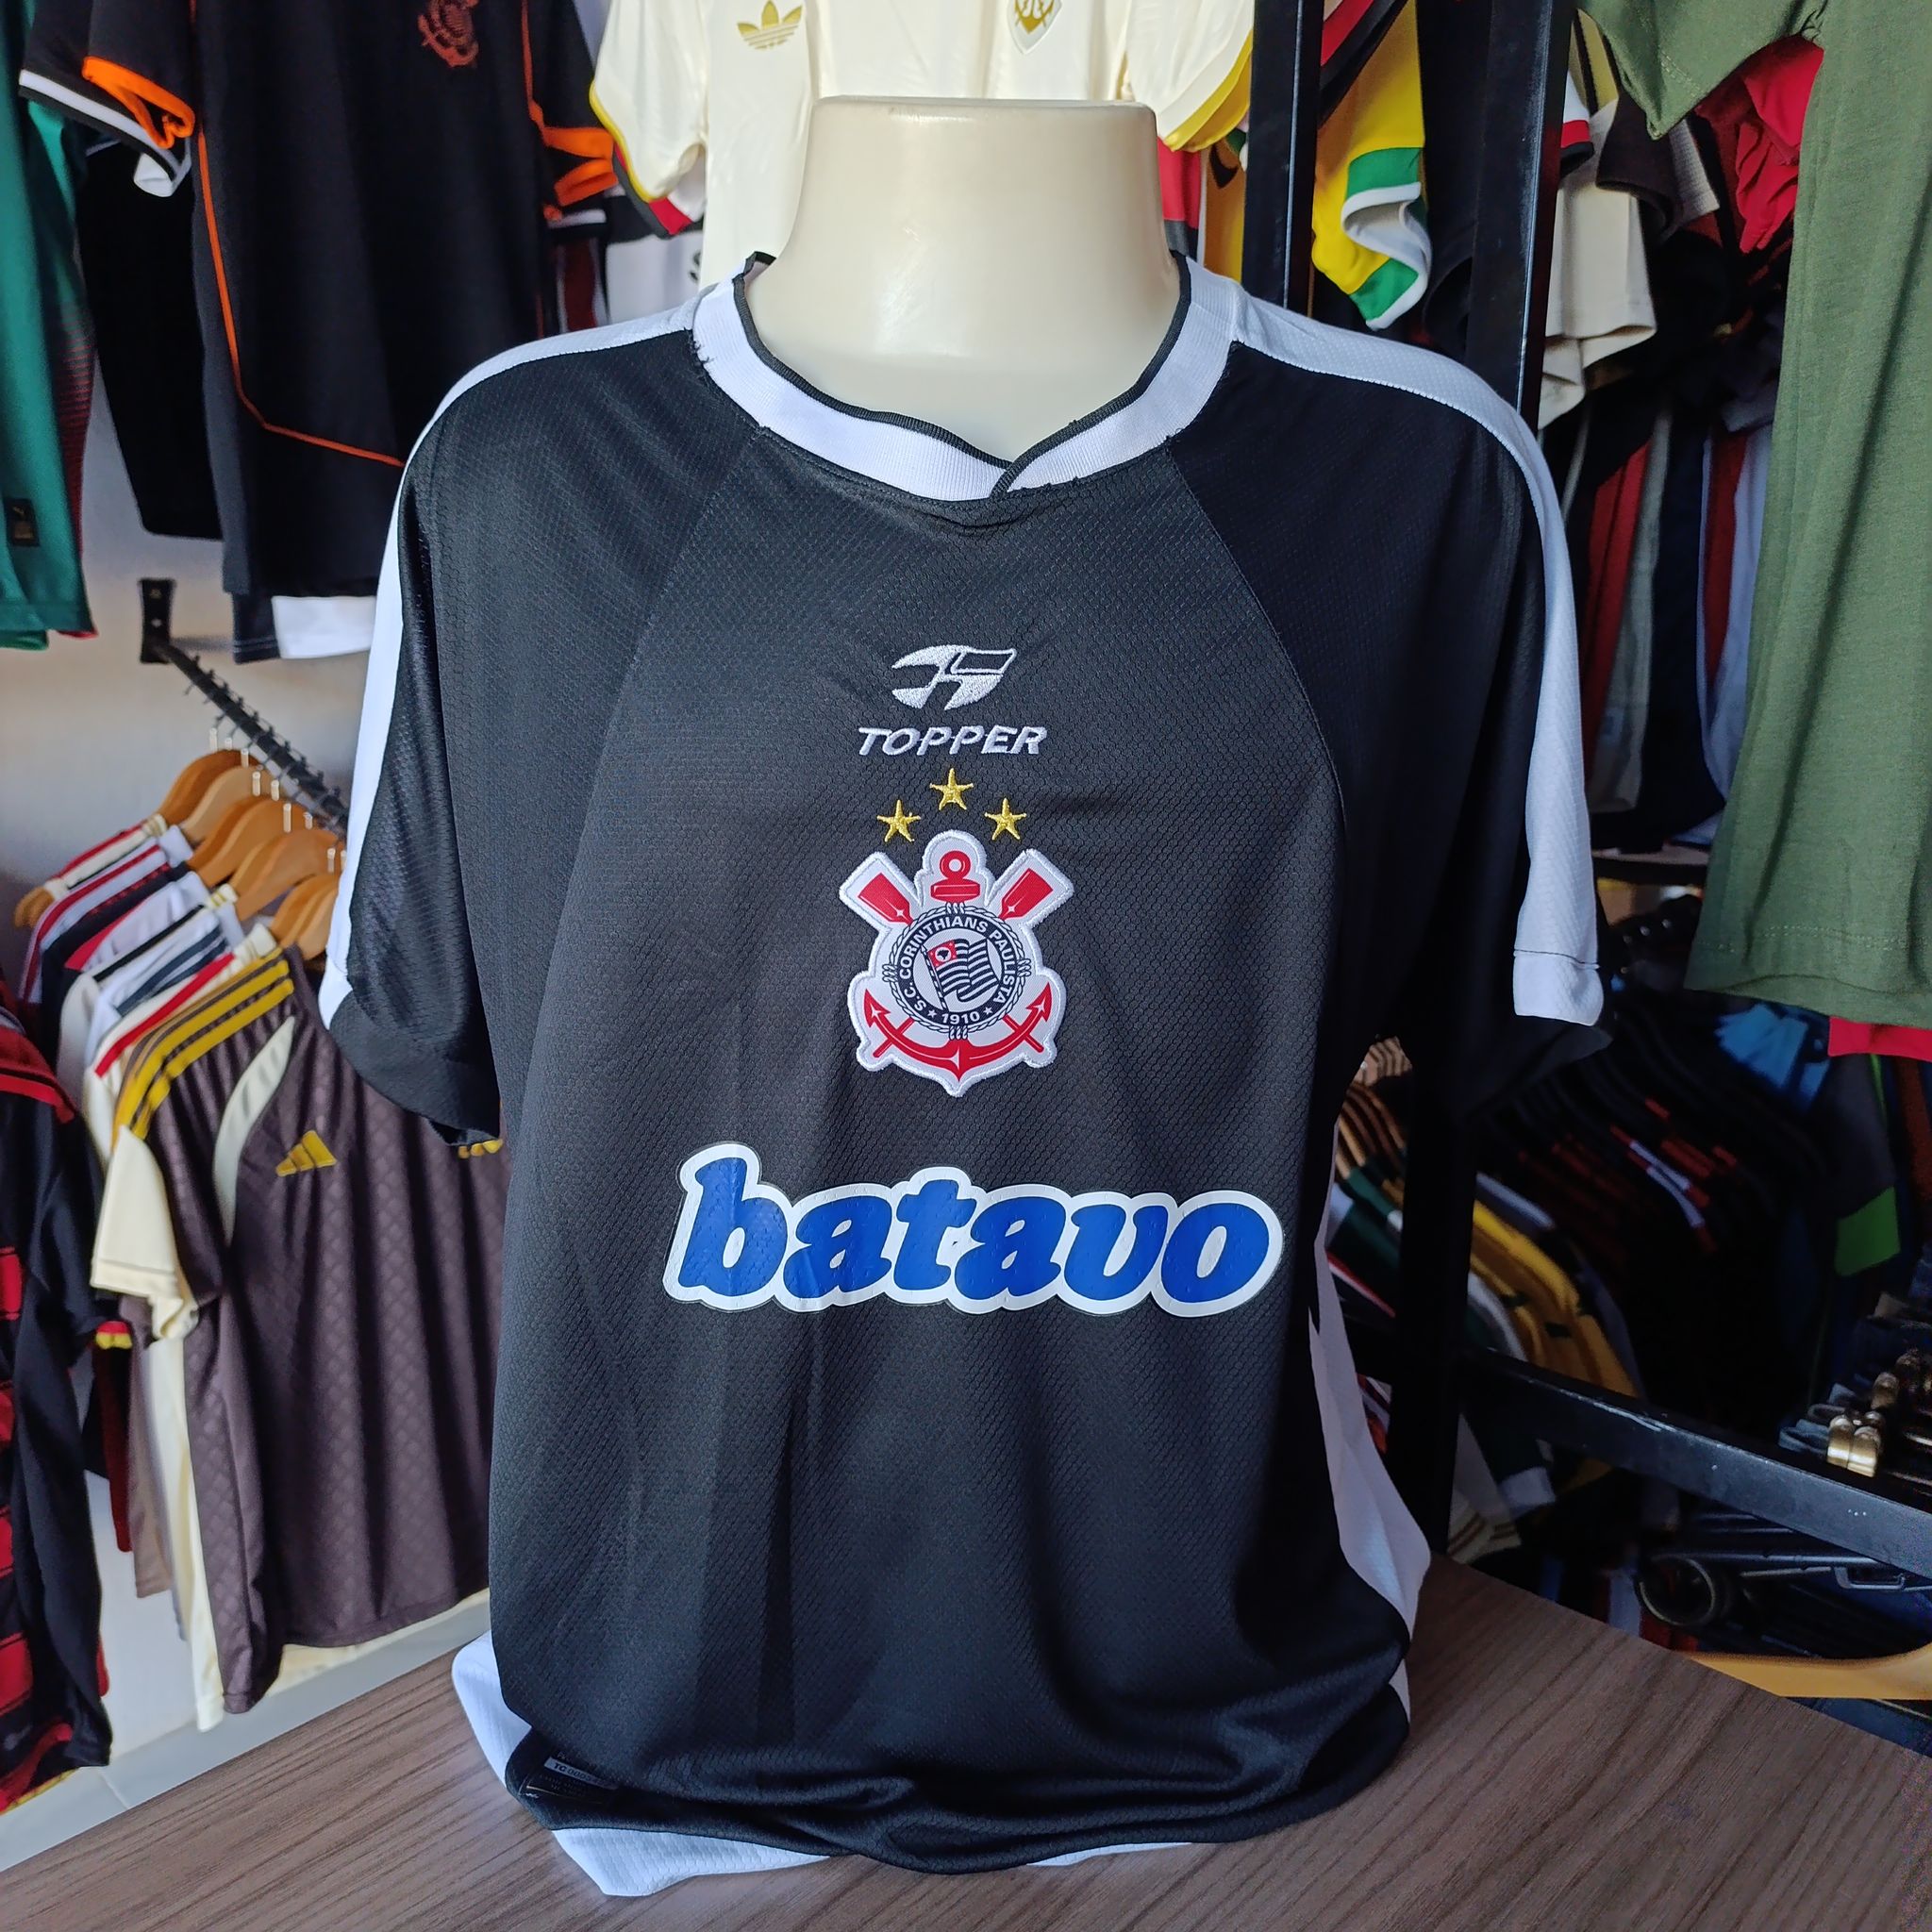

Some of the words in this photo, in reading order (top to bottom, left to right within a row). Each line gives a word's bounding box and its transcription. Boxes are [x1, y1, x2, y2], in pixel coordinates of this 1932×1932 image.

[858, 724, 1048, 756] TOPPER
[899, 915, 989, 980] CORINTHIANS
[989, 929, 1016, 1005] PAULISTA
[903, 982, 927, 1012] S.C.
[941, 1010, 980, 1024] 1910
[675, 1154, 1274, 1307] batavo
